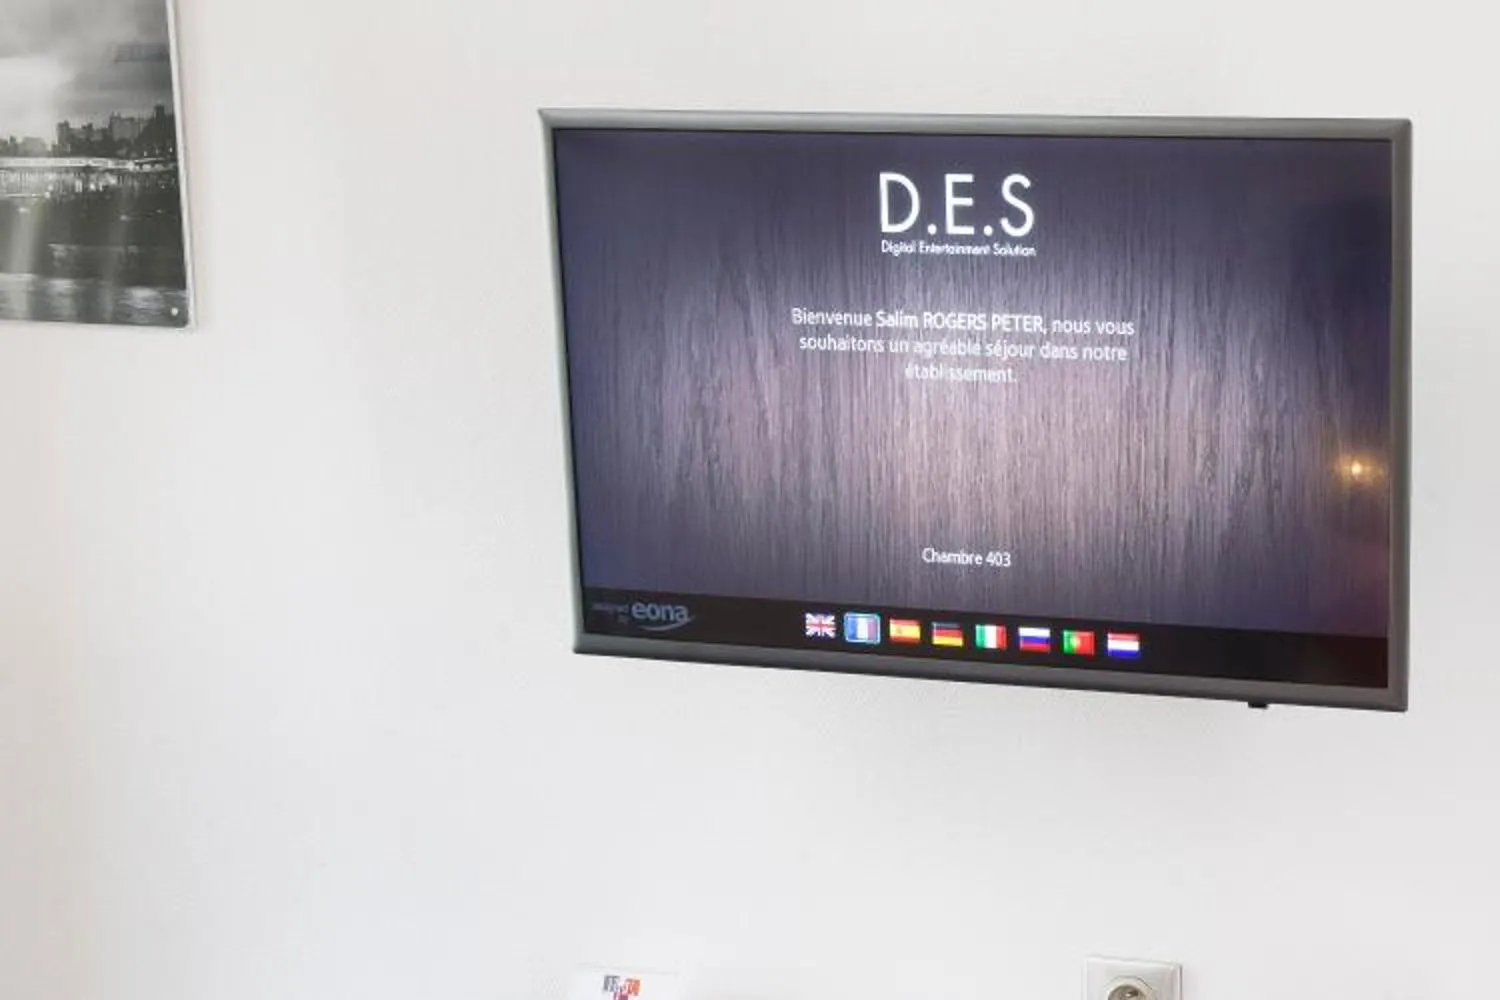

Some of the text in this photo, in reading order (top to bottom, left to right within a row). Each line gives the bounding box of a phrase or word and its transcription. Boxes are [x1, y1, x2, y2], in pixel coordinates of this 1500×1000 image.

[880, 172, 1035, 237] D.E.S
[881, 239, 1037, 257] Digital Entertainment Solution
[791, 307, 1136, 336] Bienvenue Salim ROGERS PETER, nous vous
[799, 333, 1127, 361] souhaitons un agréable séjour dans notre
[922, 547, 1011, 567] Chambre 403
[631, 602, 689, 622] eona
